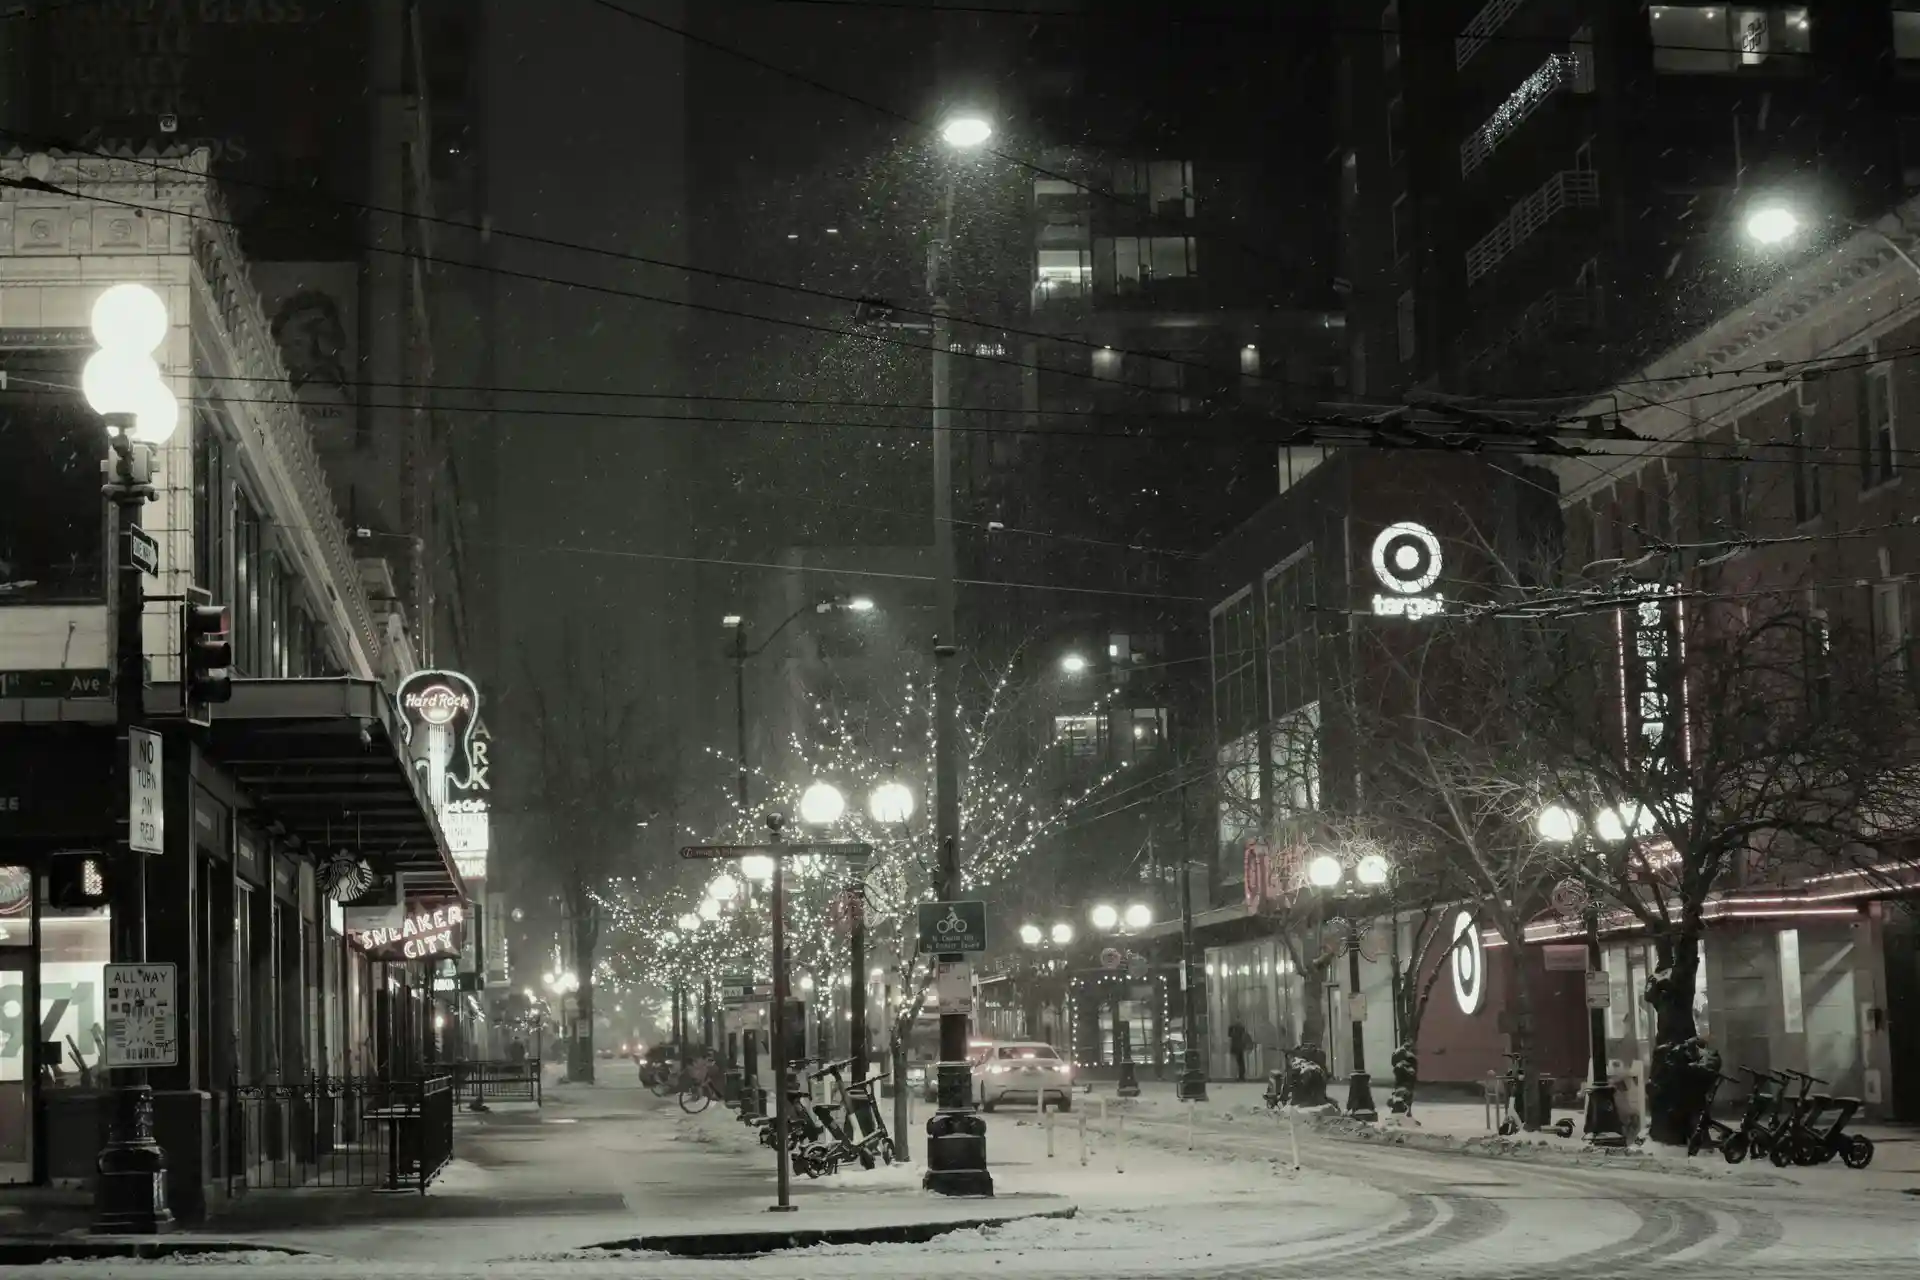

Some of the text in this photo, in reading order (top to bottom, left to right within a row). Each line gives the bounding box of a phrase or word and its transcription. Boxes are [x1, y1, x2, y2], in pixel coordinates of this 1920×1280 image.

[70, 675, 101, 692] Ave
[405, 692, 470, 711] Hard Rock
[140, 740, 154, 764] NO
[137, 768, 157, 790] TURN
[140, 821, 155, 842] RED
[361, 905, 463, 950] SNEAKER
[403, 929, 452, 959] CITY
[114, 970, 168, 984] ALL WAY
[124, 986, 157, 999] WALK
